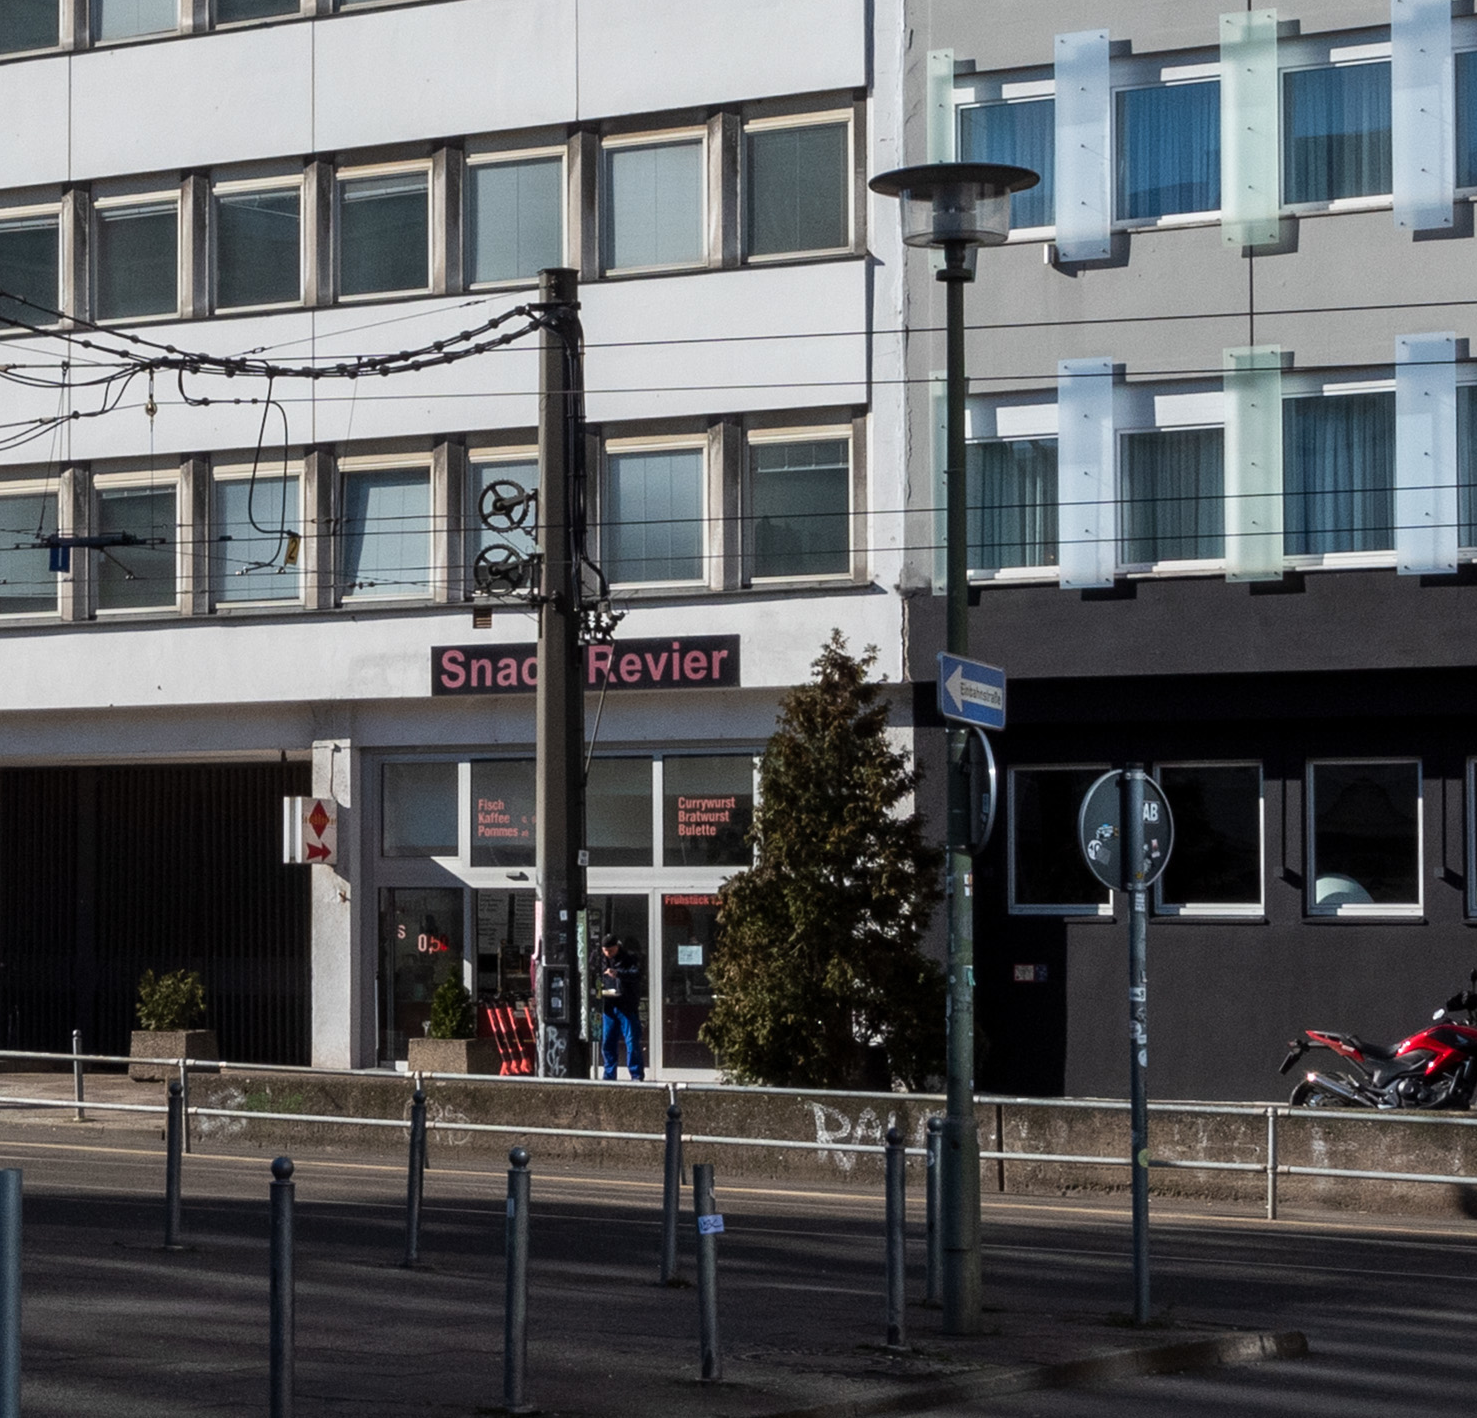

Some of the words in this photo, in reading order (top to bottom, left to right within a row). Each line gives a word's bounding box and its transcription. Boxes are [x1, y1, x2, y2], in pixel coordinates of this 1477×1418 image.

[287, 538, 297, 560] 2
[440, 648, 538, 689] Snac
[587, 640, 729, 684] Revier
[960, 681, 1001, 705] Einbahnstraße
[478, 798, 505, 811] Fisch
[678, 796, 736, 810] Currywurst
[478, 811, 510, 824] Kaffee
[678, 810, 730, 823] Bratwurst
[478, 825, 519, 837] Pommes
[678, 824, 717, 836] Bulette
[664, 894, 709, 906] Frühstück
